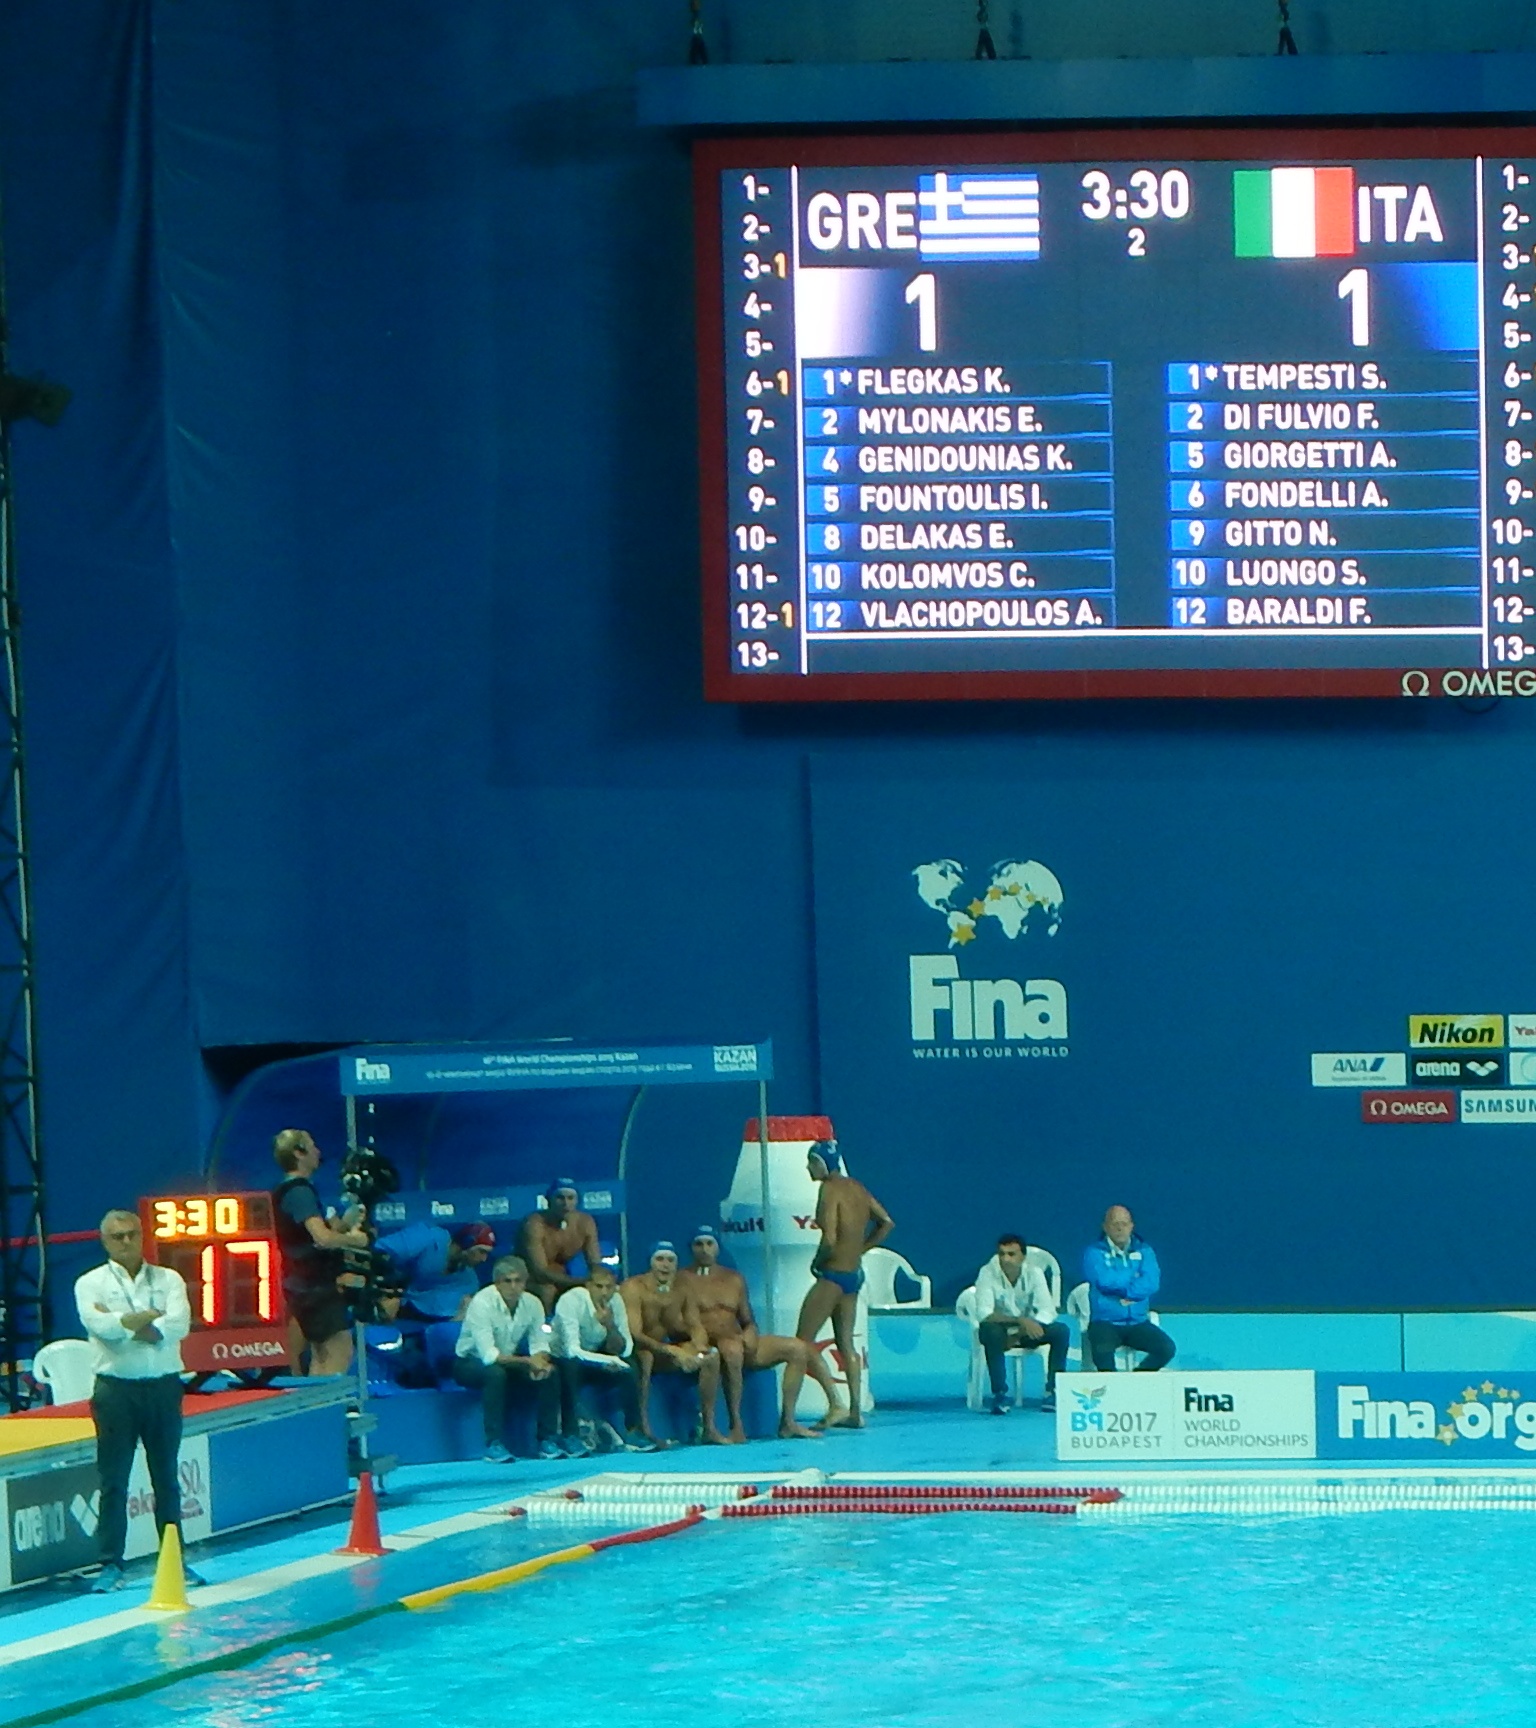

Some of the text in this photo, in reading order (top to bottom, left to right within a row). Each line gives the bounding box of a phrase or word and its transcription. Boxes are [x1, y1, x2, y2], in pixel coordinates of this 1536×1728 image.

[1081, 169, 1192, 222] 3:30
[806, 188, 918, 252] GRE
[1356, 182, 1444, 243] ITA
[1127, 228, 1146, 257] 2
[904, 272, 938, 351] 1
[1337, 266, 1370, 347] 1
[857, 368, 978, 396] FLEGKAS
[984, 367, 1012, 394] K.
[1222, 366, 1356, 392] TEMPESTI
[1360, 366, 1388, 391] S.
[821, 406, 1044, 434] 2 MYLONAKIS E.
[1186, 403, 1380, 432] 2 DI FULVIO F.
[821, 444, 1074, 474] 4 GENIDOUNIAS K.
[1186, 442, 1398, 470] 5 GIORGETTI A.
[821, 485, 1049, 512] 5 FOUNTOULIS I.
[1186, 481, 1389, 509] 6 FONDELLI A.
[822, 523, 1014, 552] 8 DELAKAS E.
[1188, 520, 1337, 548] 9 GITTO N.
[811, 562, 1036, 590] 10 KOLOMVOS C.
[1176, 558, 1367, 587] 10 LUONGO S.
[811, 600, 1104, 630] 12 VLACHOPOULOS A.
[1176, 597, 1372, 626] 12 BARALDI F.
[909, 954, 1068, 1040] Fina
[1419, 1022, 1494, 1044] Nikon
[913, 1047, 1068, 1058] WATER IS OUR WORLD
[1333, 1058, 1368, 1072] ANA
[1416, 1061, 1460, 1076] arena
[1391, 1102, 1448, 1114] OMEGA
[154, 1198, 238, 1238] 3:30
[201, 1240, 270, 1324] 17
[231, 1342, 284, 1358] OMEGA
[1183, 1387, 1235, 1413] Fina
[1106, 1412, 1158, 1433] 2017
[1184, 1419, 1241, 1432] WORLD
[1070, 1435, 1162, 1449] BUDAPEST
[1183, 1432, 1309, 1448] CHAMPIONSHIPS
[15, 1500, 65, 1551] arena
